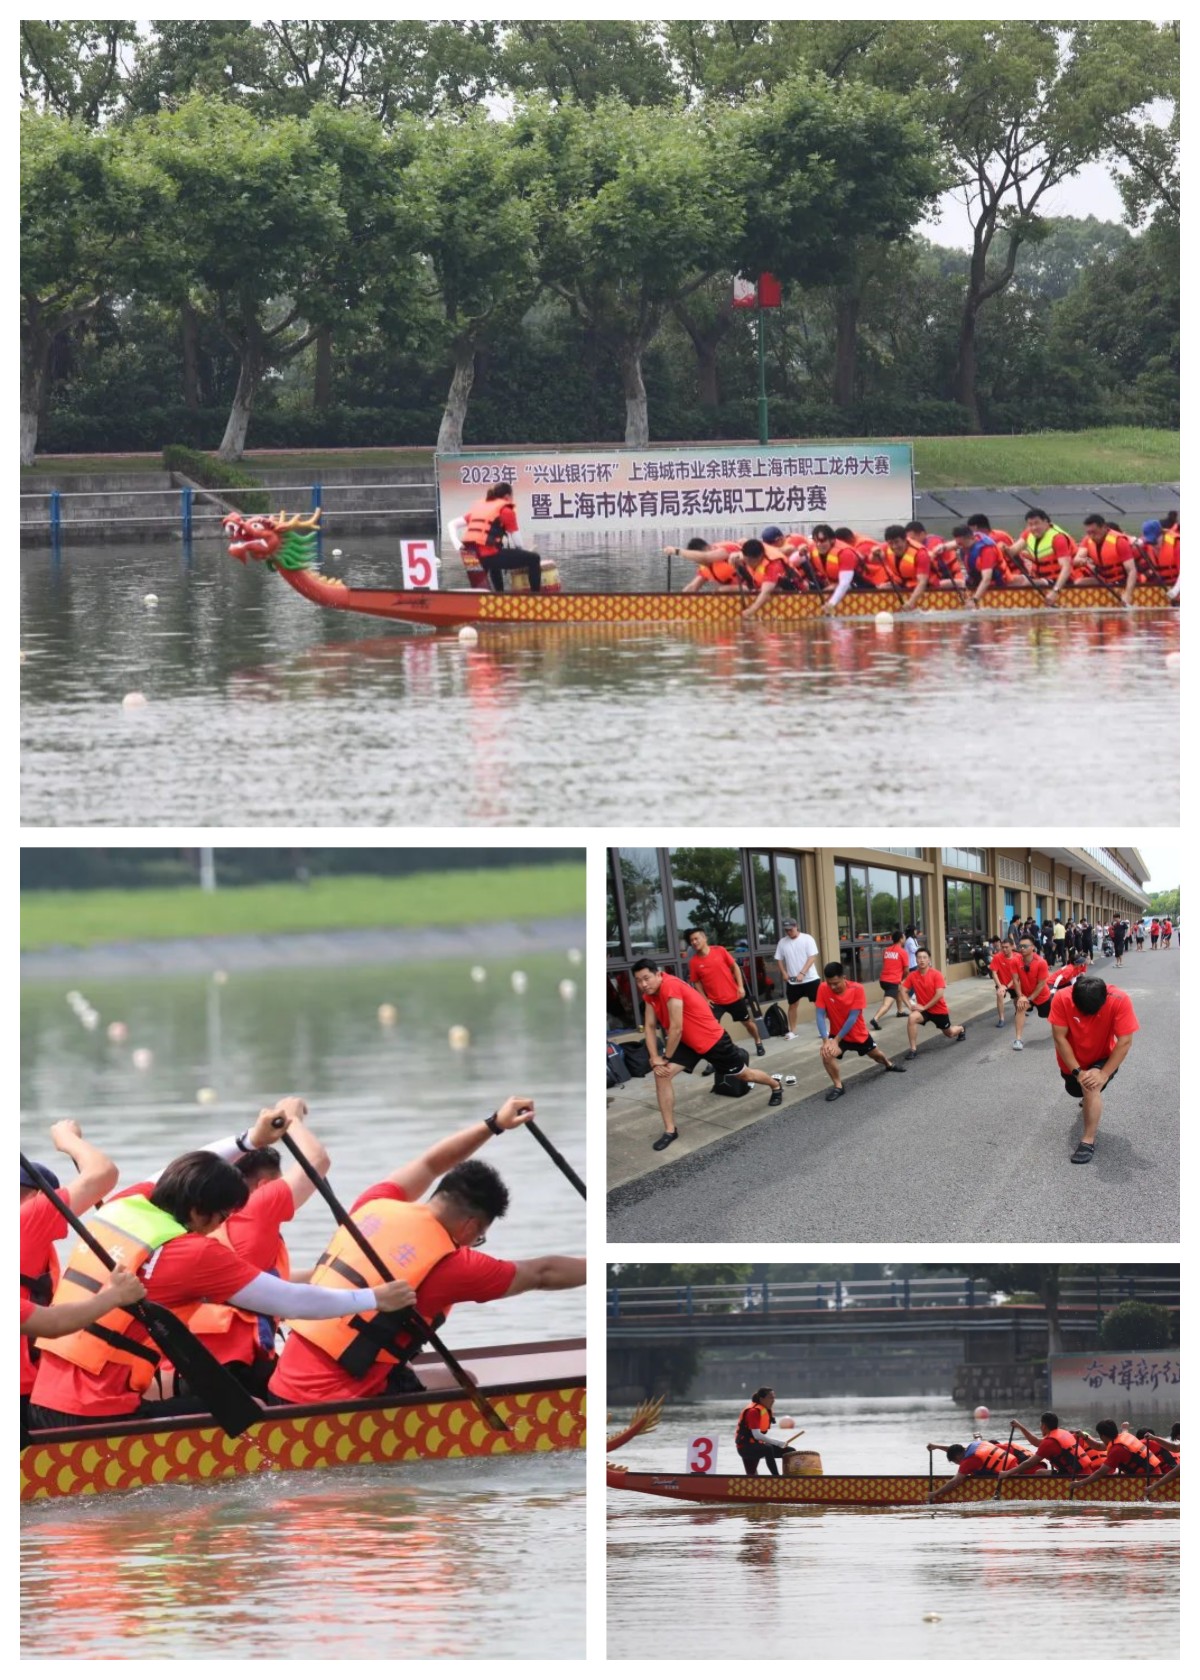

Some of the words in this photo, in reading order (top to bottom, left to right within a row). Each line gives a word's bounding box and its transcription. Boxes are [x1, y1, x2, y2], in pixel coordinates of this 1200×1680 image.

[530, 485, 828, 520] 暨上海市体育局系统职工龙舟赛
[407, 543, 432, 587] 5
[690, 1437, 713, 1472] 3
